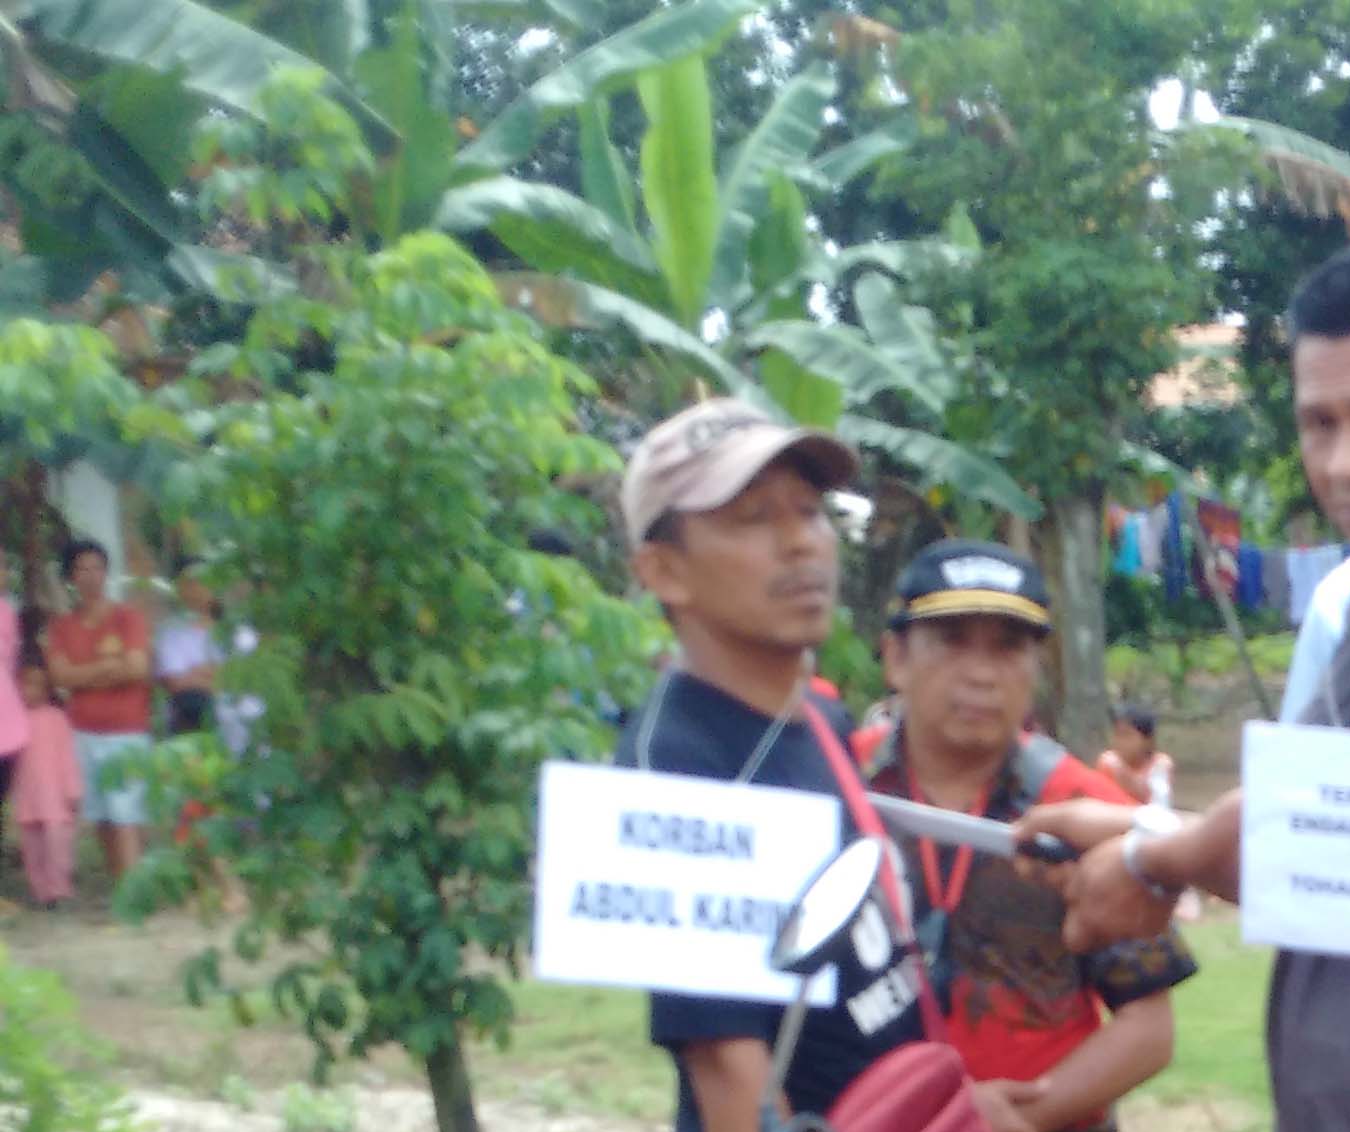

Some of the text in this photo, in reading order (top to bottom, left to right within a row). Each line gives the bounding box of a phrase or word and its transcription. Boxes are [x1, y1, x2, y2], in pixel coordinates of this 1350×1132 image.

[618, 810, 755, 859] KORBAN
[568, 881, 681, 928] ABDUL
[692, 893, 800, 938] KARI
